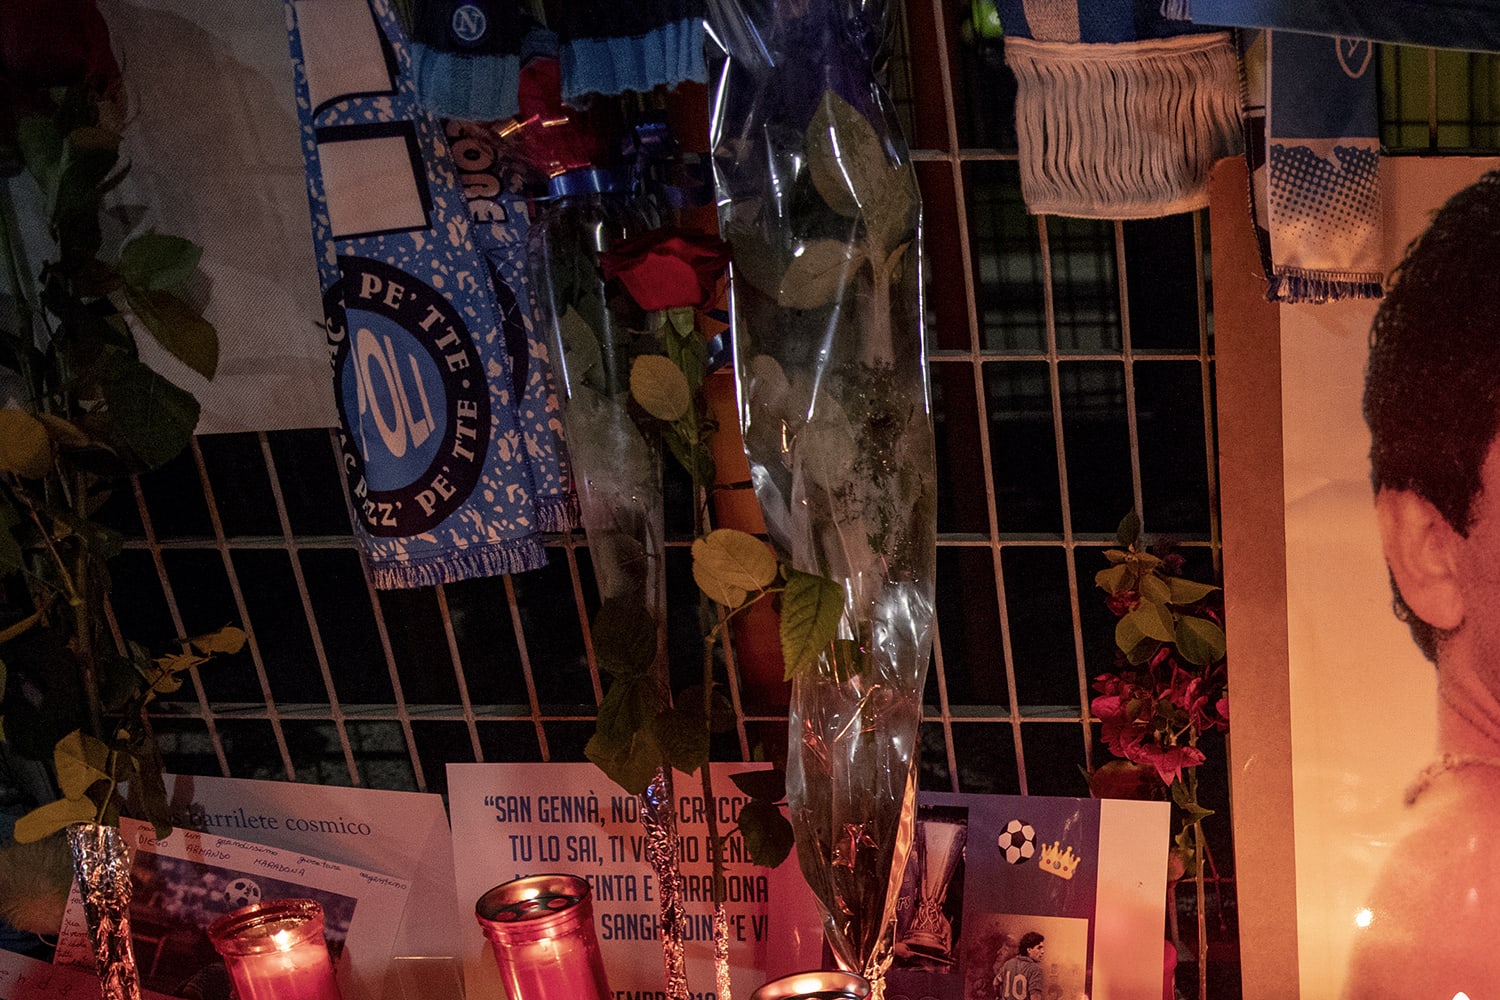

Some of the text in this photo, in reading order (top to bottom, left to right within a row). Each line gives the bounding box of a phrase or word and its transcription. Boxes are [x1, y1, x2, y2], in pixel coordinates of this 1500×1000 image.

[419, 304, 471, 374] TTE
[189, 803, 279, 832] barrilete
[286, 816, 372, 836] cosmico
[612, 796, 642, 822] NO
[186, 843, 231, 861] ARMANDO
[253, 858, 306, 878] MARADONA
[509, 836, 531, 862] TU
[538, 836, 560, 862] LO
[567, 836, 603, 866] SAI,
[610, 836, 625, 862] TI
[631, 836, 699, 862] VIO
[644, 875, 654, 901] E
[679, 875, 768, 902] ARAONA
[601, 914, 661, 940] SANGH
